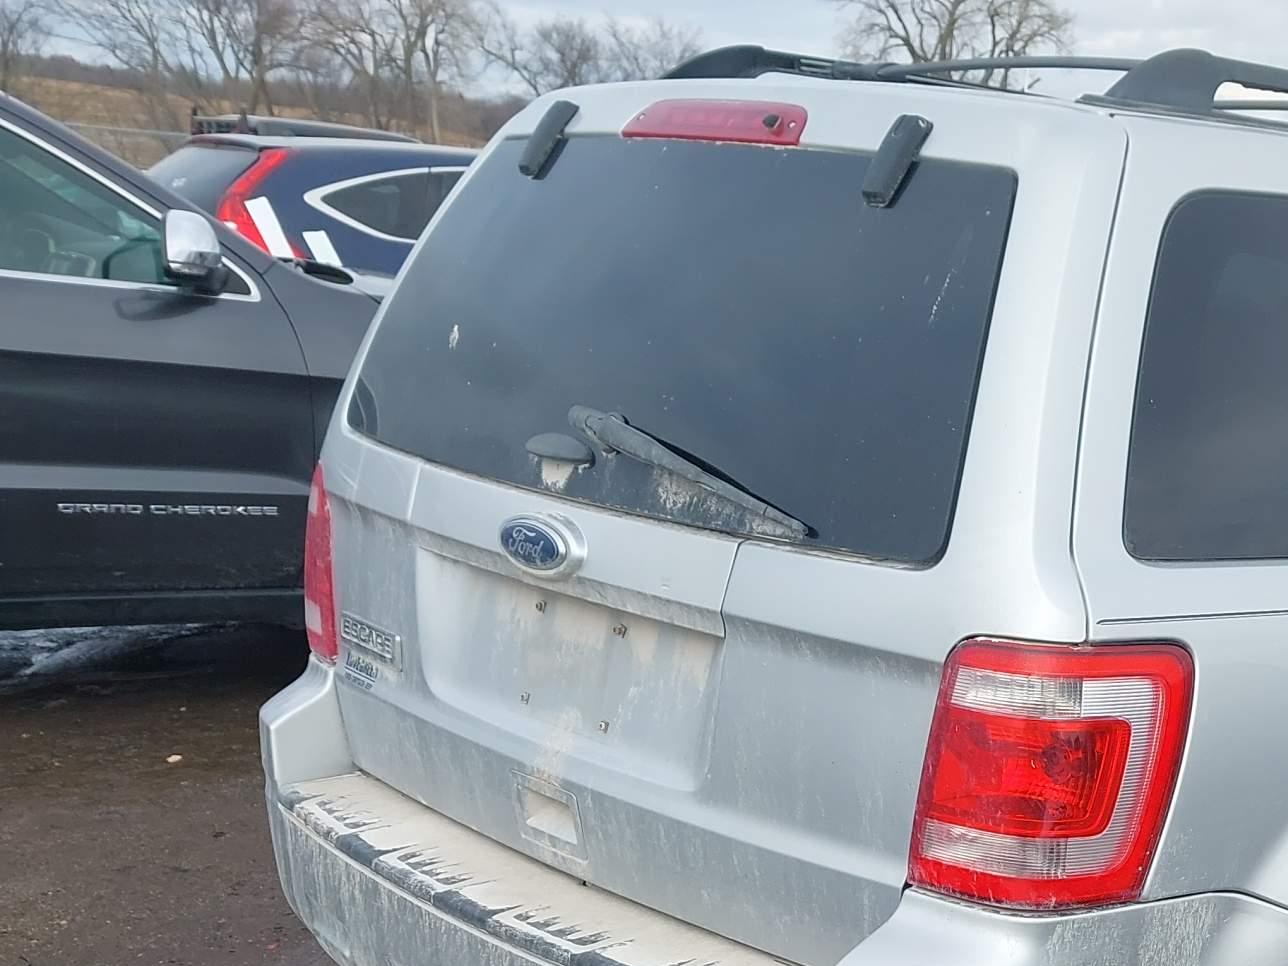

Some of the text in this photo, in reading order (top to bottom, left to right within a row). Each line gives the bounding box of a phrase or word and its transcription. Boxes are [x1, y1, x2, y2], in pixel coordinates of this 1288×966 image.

[56, 502, 279, 516] GRAND CHEROKEE
[507, 525, 546, 559] Ford
[342, 615, 393, 658] ESCAPE
